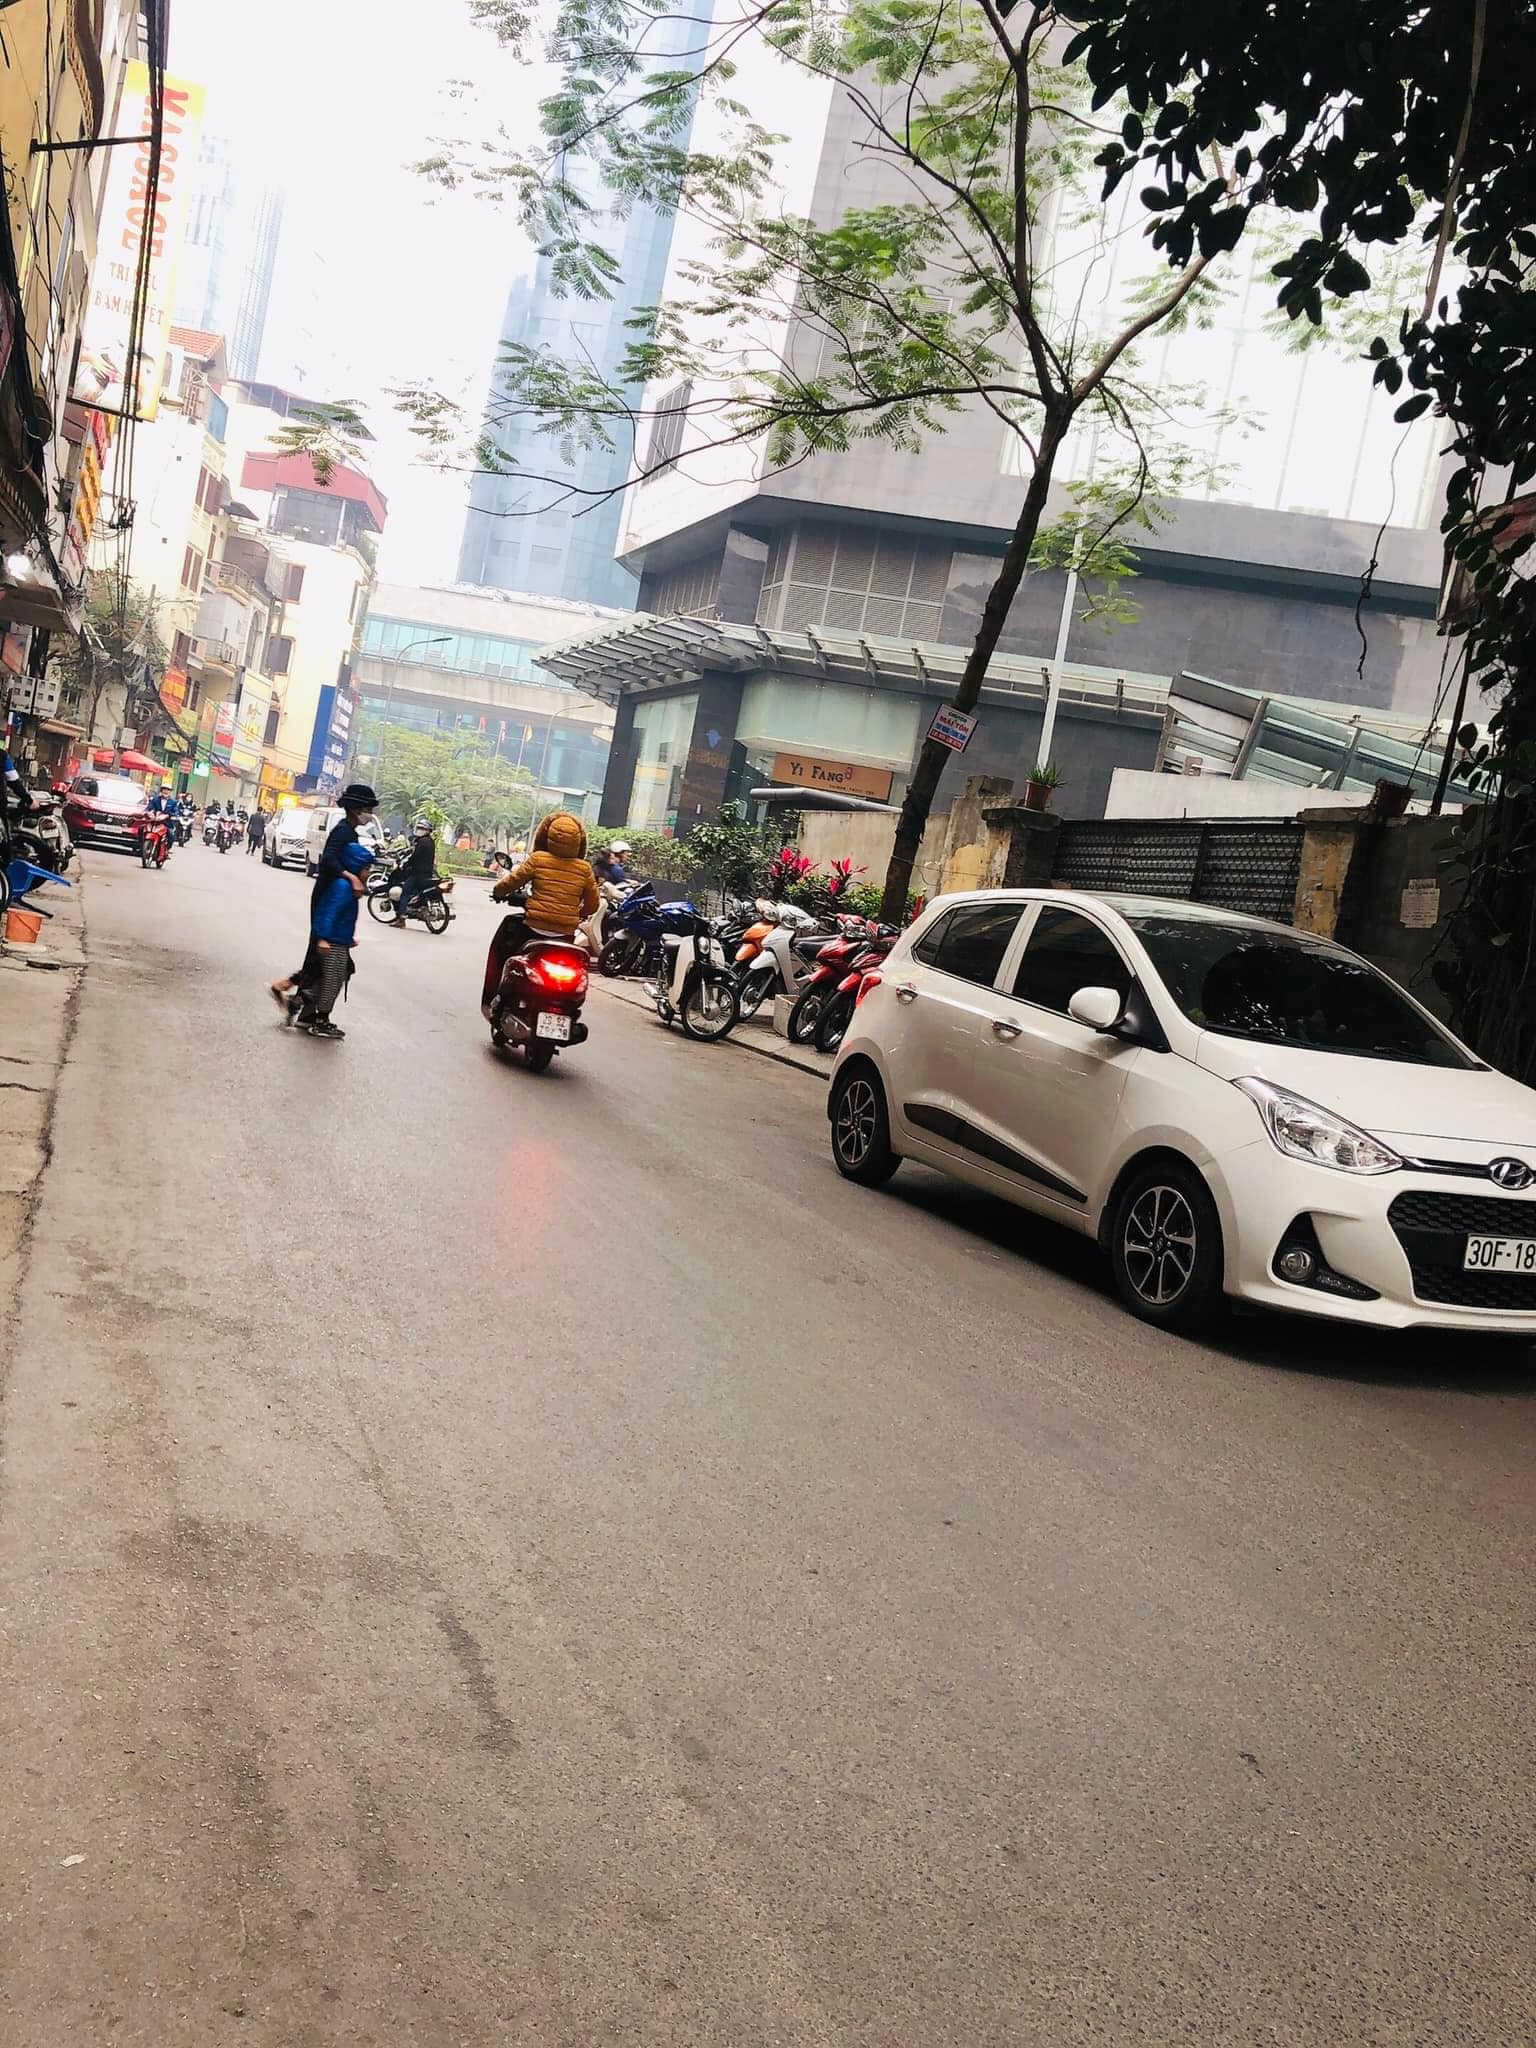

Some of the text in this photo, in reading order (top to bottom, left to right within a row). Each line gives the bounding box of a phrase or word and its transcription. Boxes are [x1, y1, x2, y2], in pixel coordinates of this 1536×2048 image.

[121, 87, 189, 257] MASSAGE
[811, 765, 844, 783] FANG
[1468, 1239, 1536, 1270] 30F-18
